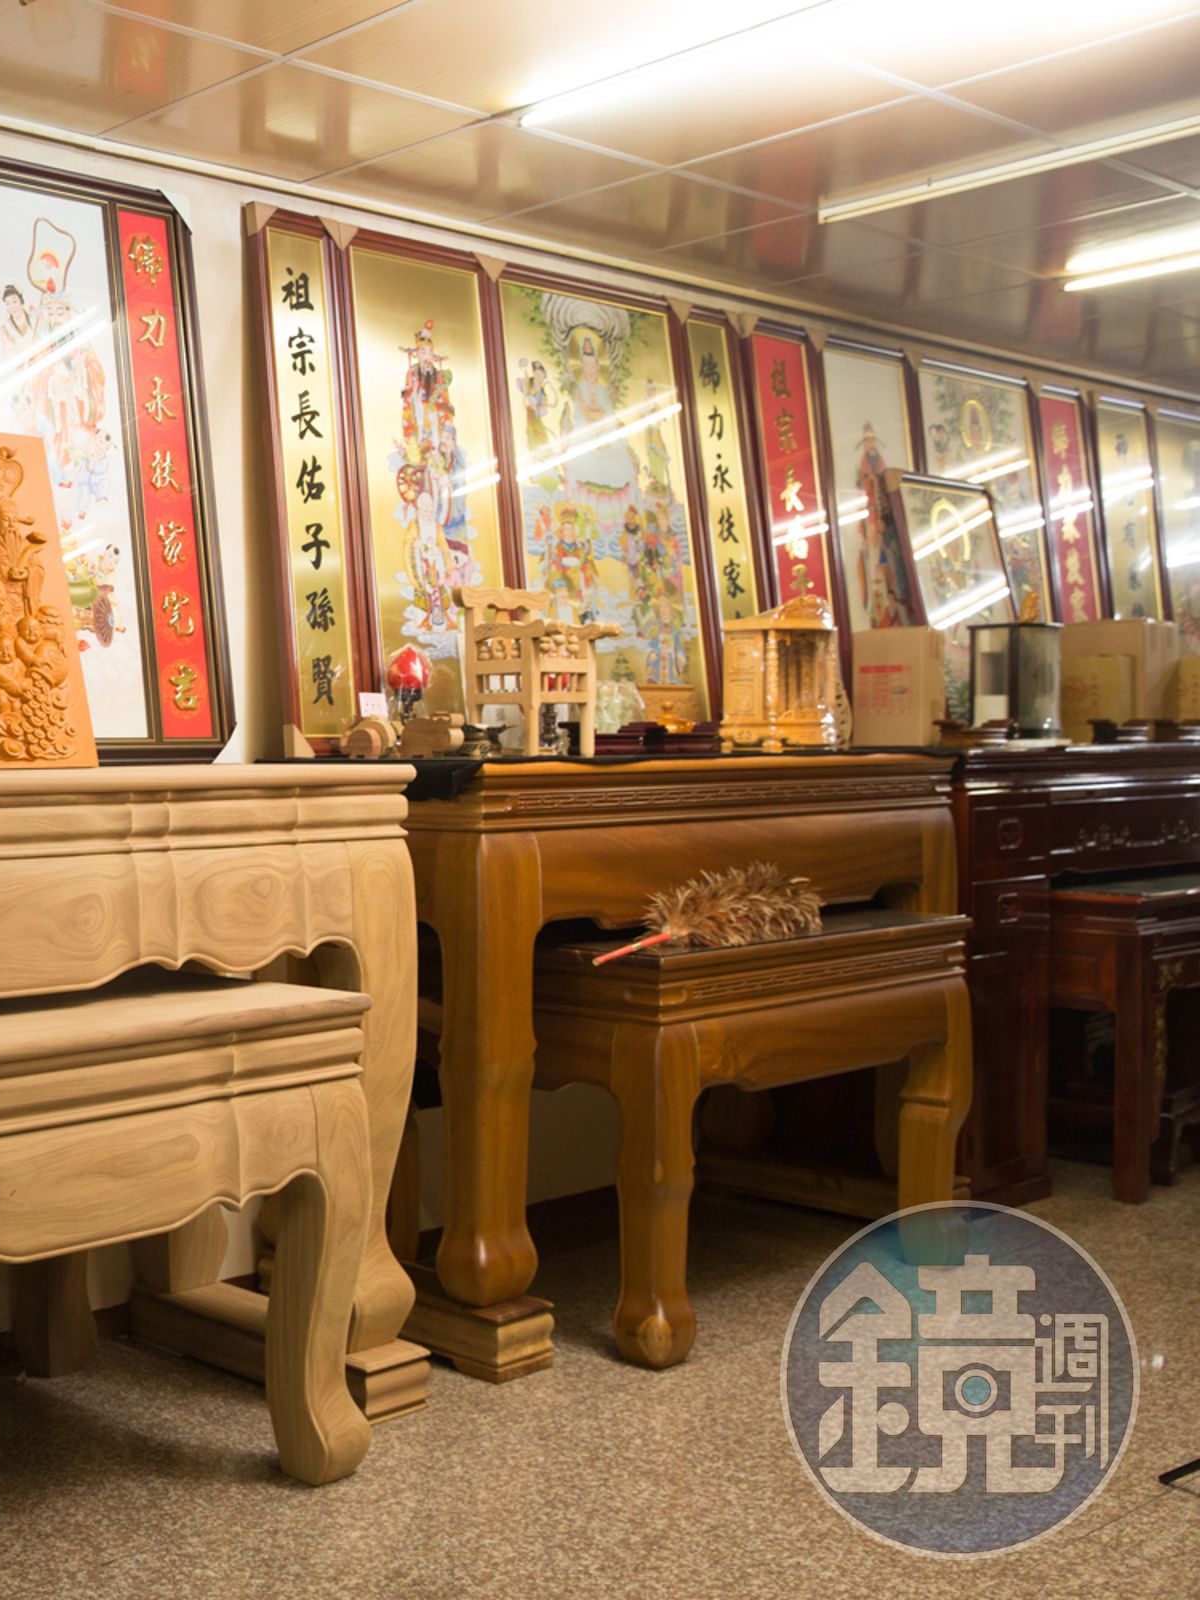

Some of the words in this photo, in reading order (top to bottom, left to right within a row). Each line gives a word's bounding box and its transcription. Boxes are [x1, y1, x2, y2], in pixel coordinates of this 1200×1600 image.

[281, 267, 336, 705] 祖宗長佑子孫賢
[698, 352, 745, 620] 佛力永扶家
